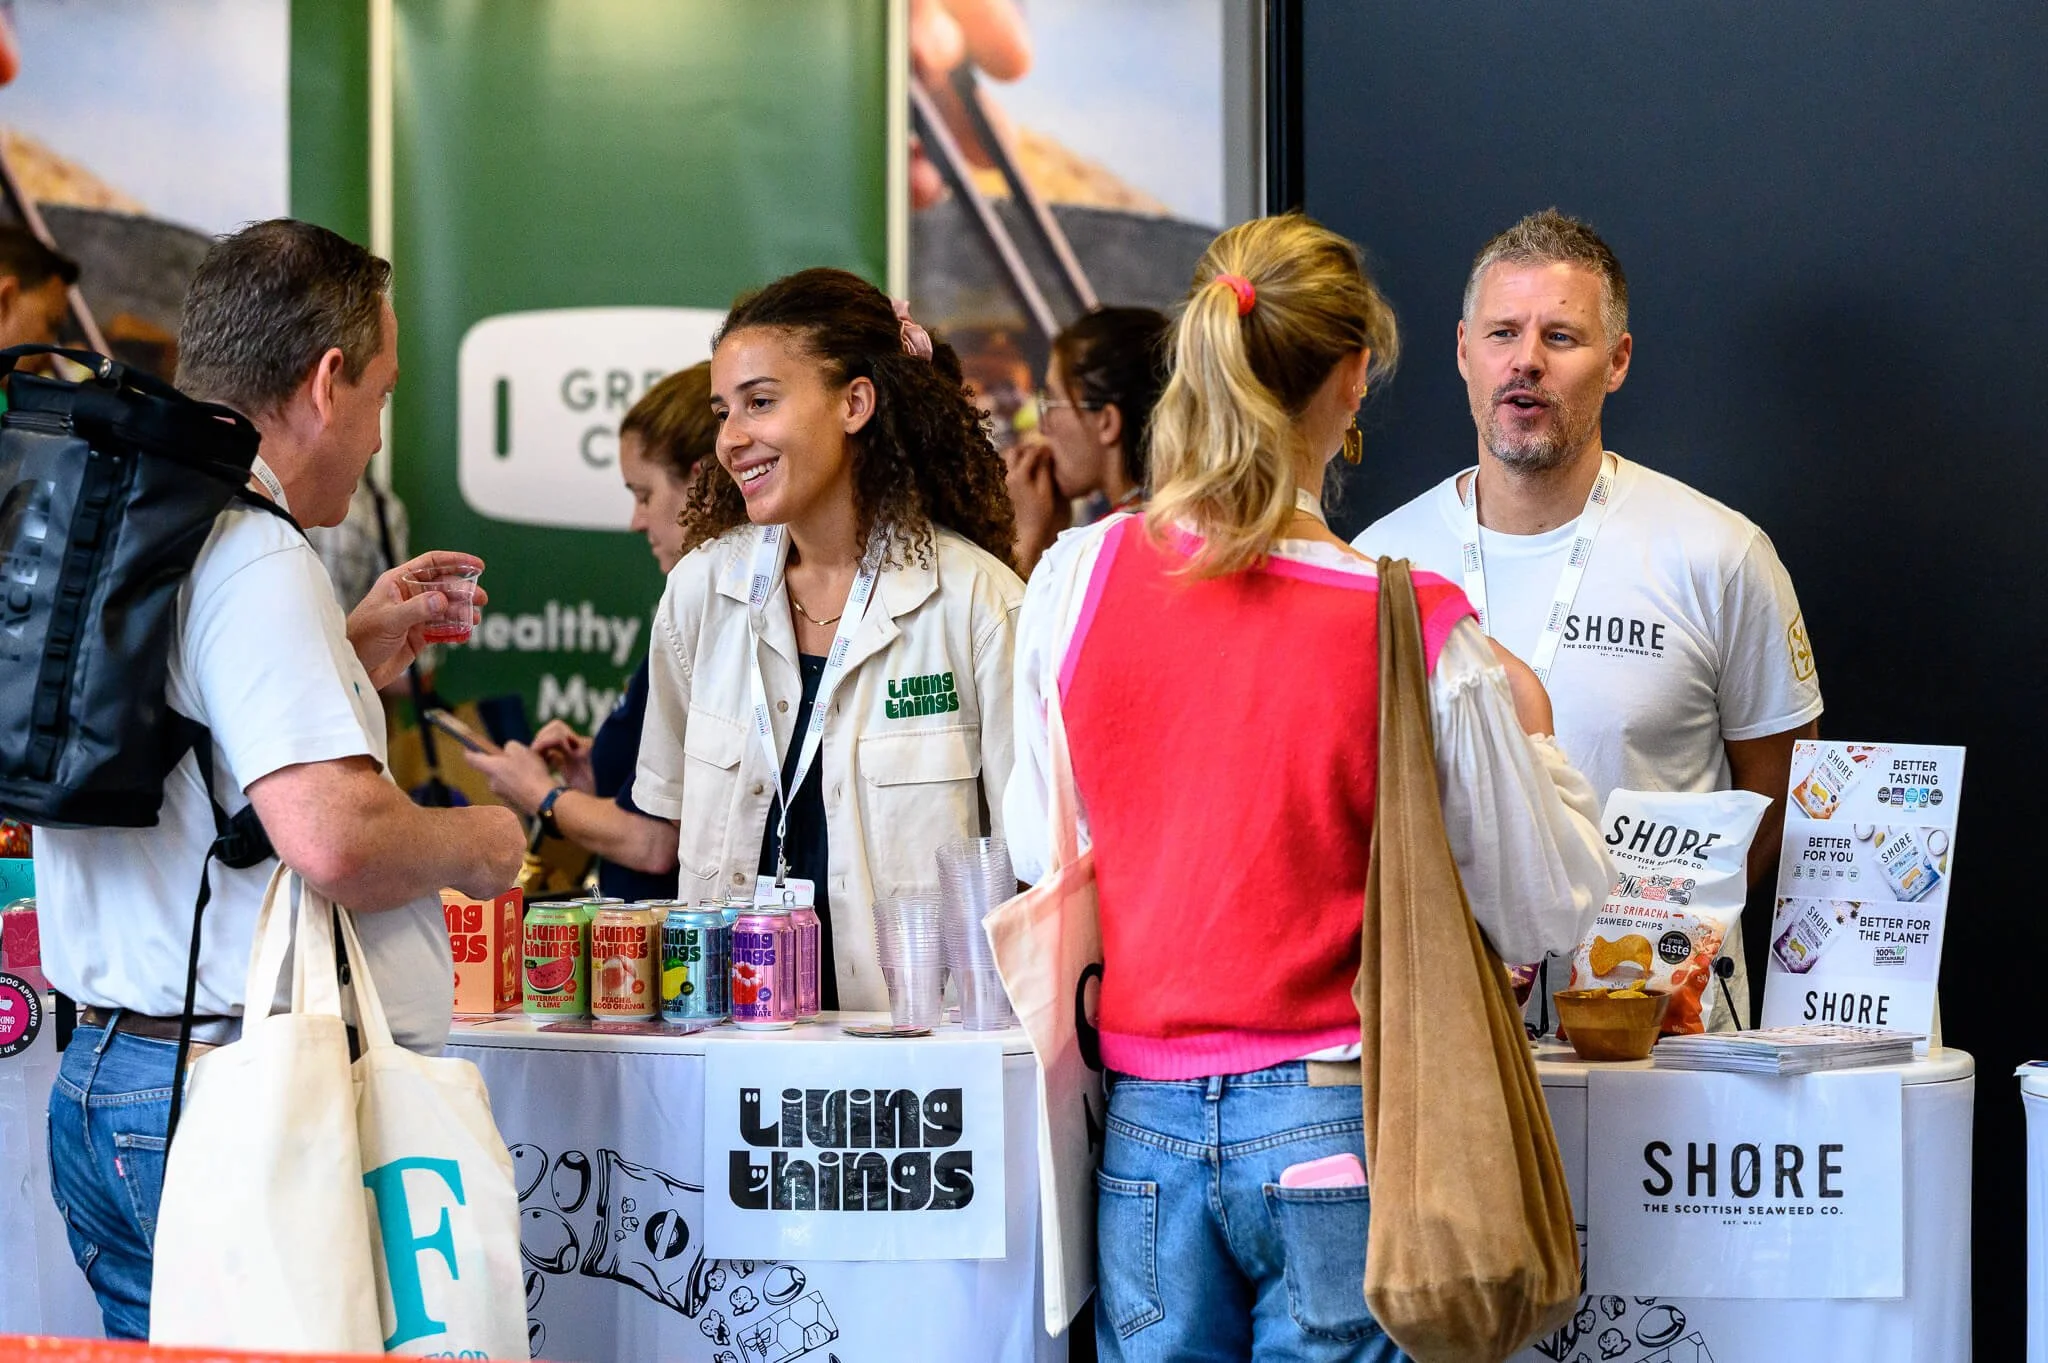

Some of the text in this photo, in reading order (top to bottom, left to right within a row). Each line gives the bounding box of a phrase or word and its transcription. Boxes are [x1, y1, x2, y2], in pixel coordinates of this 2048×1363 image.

[1615, 646, 1649, 656] SEAWEED
[885, 691, 960, 720] things
[1893, 760, 1937, 772] BETTER
[1889, 773, 1938, 786] TASTING
[1808, 837, 1851, 849] BETTER
[1616, 851, 1656, 865] SCOTTISH
[1691, 862, 1704, 870] CO.
[1803, 850, 1854, 863] FOR YOU
[1623, 905, 1669, 919] SRIRACHA
[1596, 916, 1664, 931] SEAWEED CHIPS
[1859, 916, 1931, 931] BETTER FOR
[525, 924, 580, 941] Living
[592, 925, 647, 943] Living
[1858, 930, 1930, 945] THE PLANET
[524, 941, 581, 958] things
[592, 942, 649, 960] things
[1659, 942, 1690, 956] taste
[1876, 948, 1896, 956] 100%
[527, 994, 575, 1002] WATERMELON
[536, 1001, 542, 1009] &
[601, 996, 626, 1004] PEACH
[18, 985, 38, 1027] APPROVED
[738, 1086, 964, 1149] Living
[728, 1149, 975, 1212] things
[1642, 1203, 1844, 1215] THE SCOTTISH SEAWEED CO.
[361, 1156, 467, 1353] F
